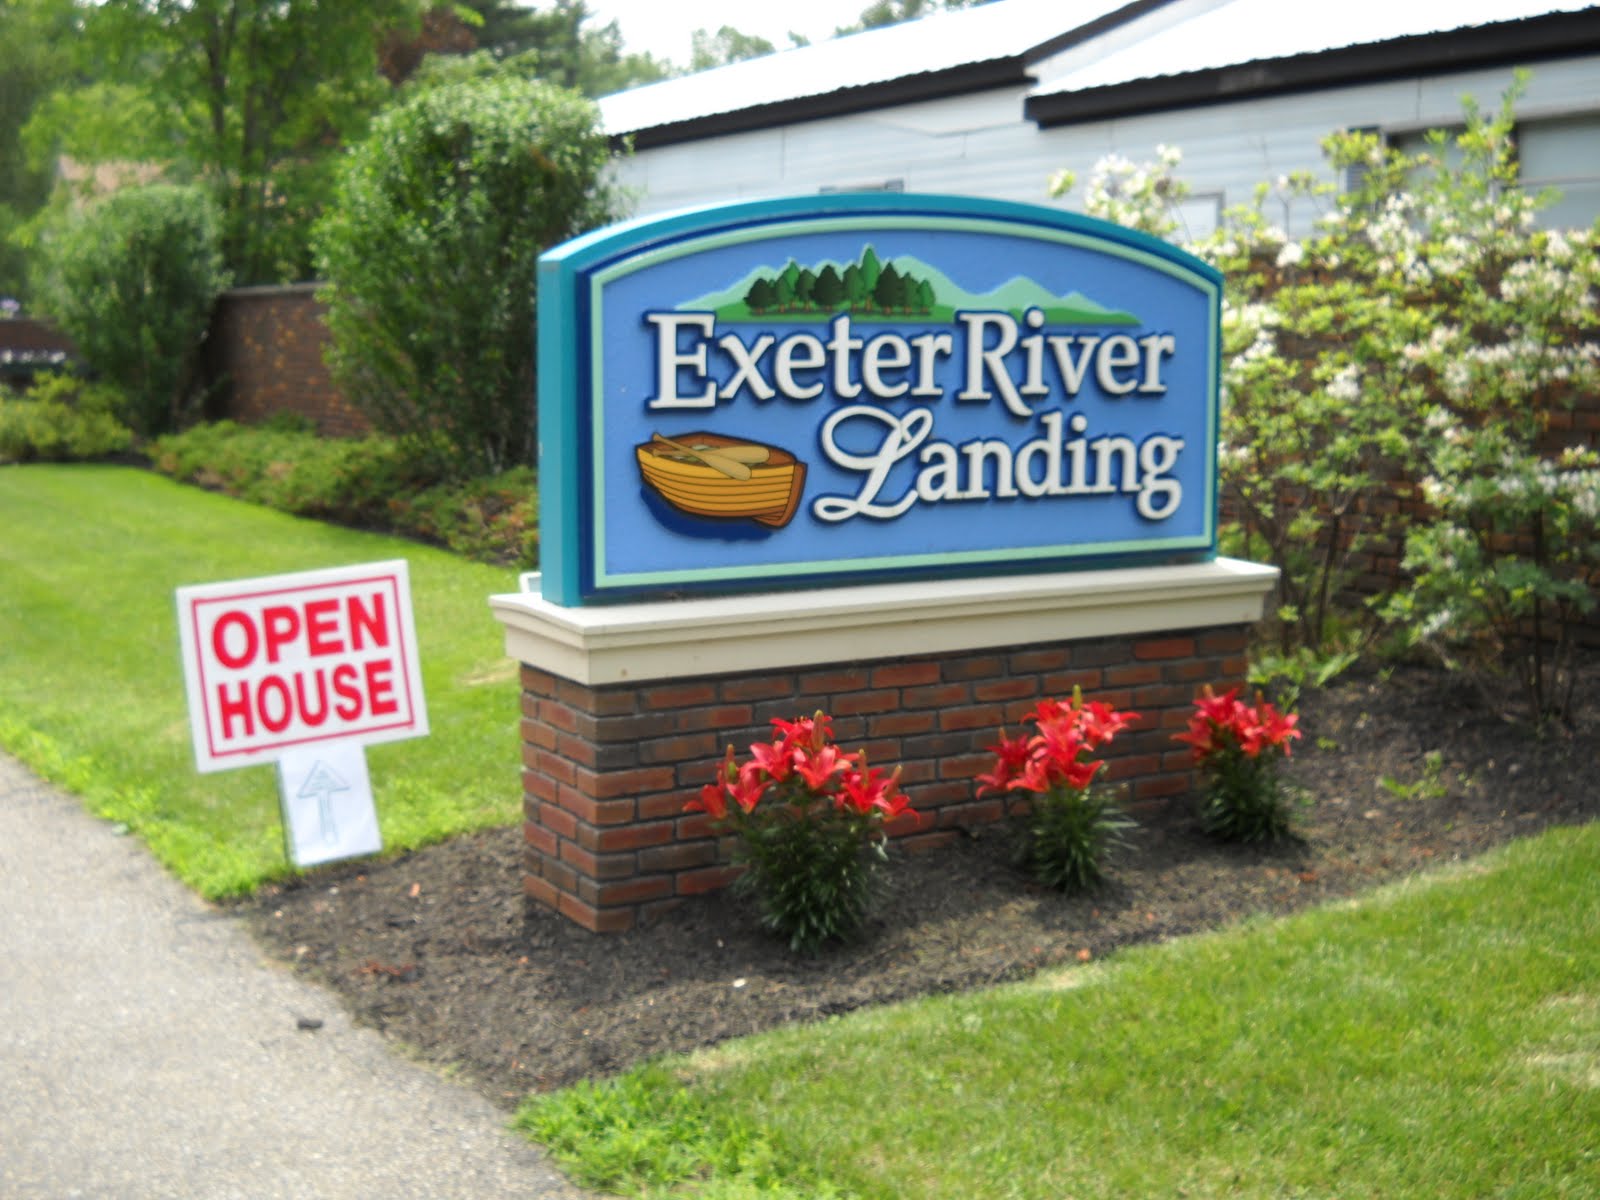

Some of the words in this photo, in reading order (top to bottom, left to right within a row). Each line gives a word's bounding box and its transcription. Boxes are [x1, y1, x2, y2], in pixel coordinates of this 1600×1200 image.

[646, 312, 952, 410] Exeter
[958, 308, 1176, 417] River
[813, 405, 1184, 522] Landing
[211, 592, 390, 671] OPEN
[217, 658, 399, 740] HOUSE
